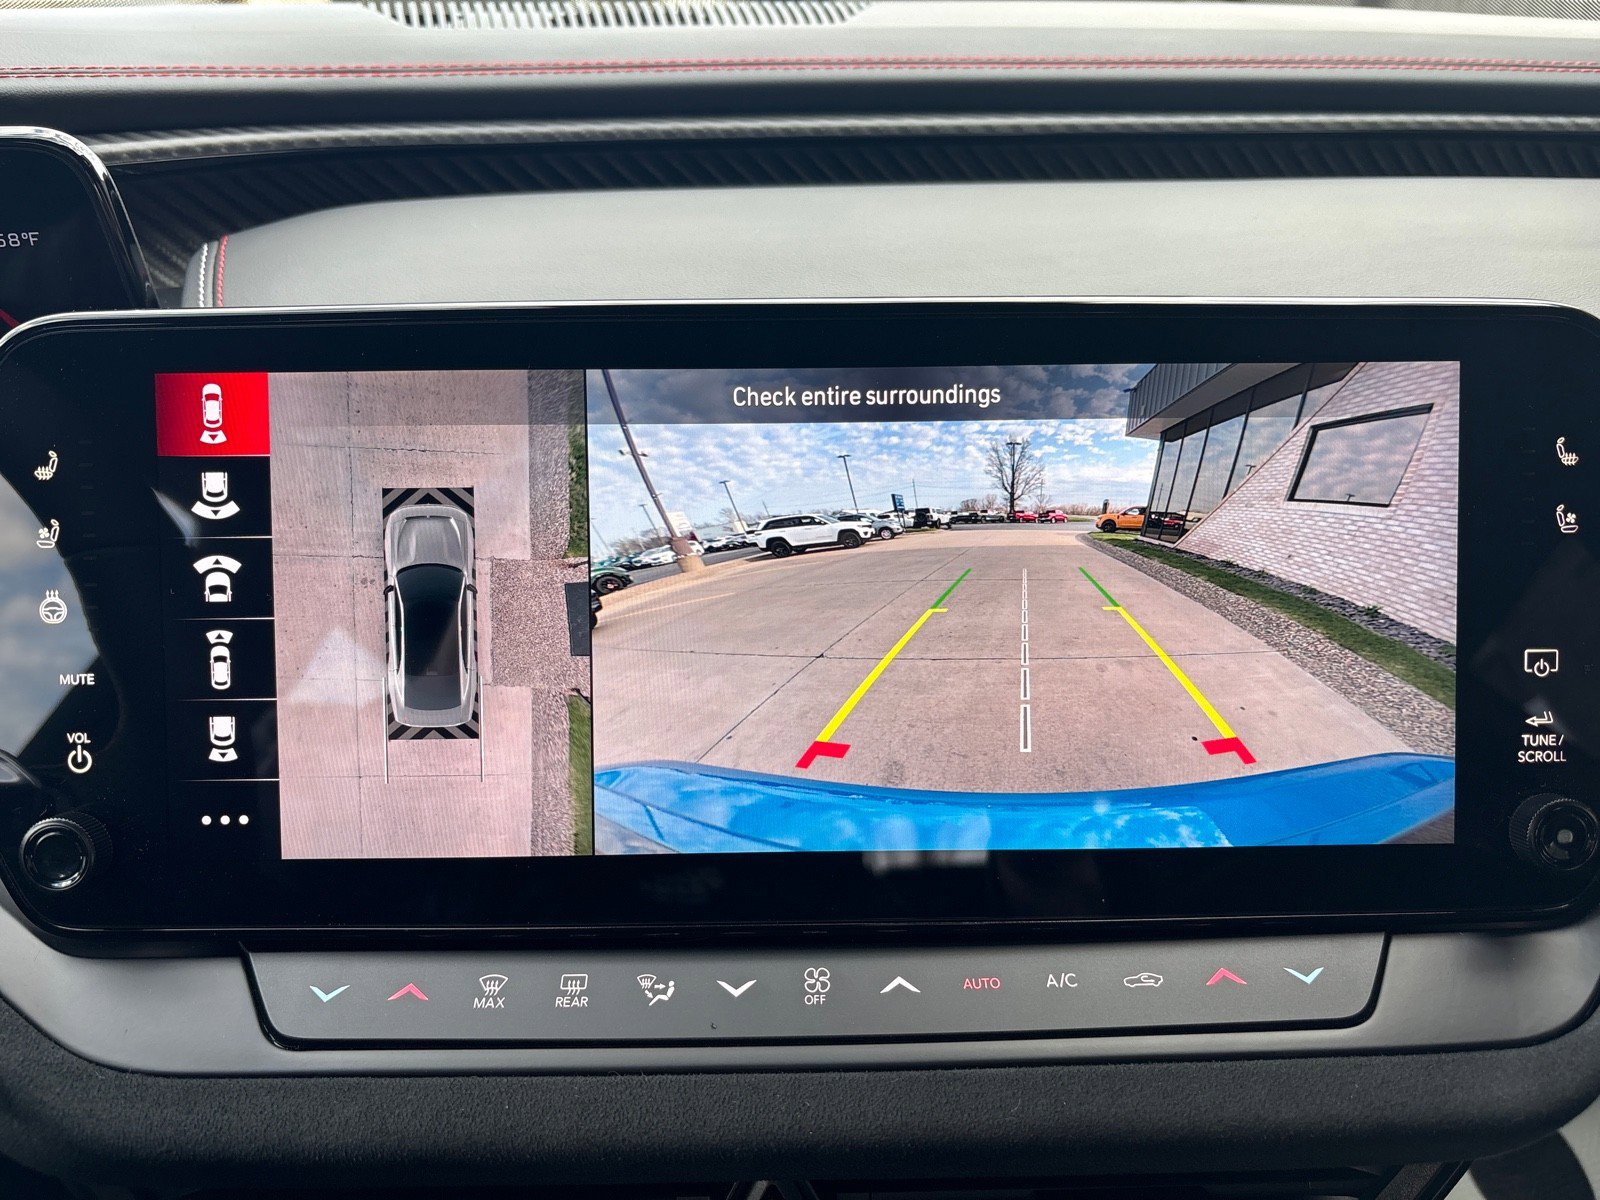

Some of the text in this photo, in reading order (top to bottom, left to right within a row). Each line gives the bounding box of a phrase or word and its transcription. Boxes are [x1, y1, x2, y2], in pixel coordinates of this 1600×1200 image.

[733, 383, 1001, 409] Check entire surroundings
[59, 673, 95, 686] MUTE
[67, 732, 91, 745] VOL
[1521, 734, 1565, 747] TUNE/
[1517, 750, 1567, 763] SCROLL
[963, 977, 1001, 990] AUTO
[1046, 972, 1078, 988] A/C
[473, 997, 506, 1009] MAX
[555, 995, 589, 1008] REAR
[804, 994, 827, 1006] OFF
